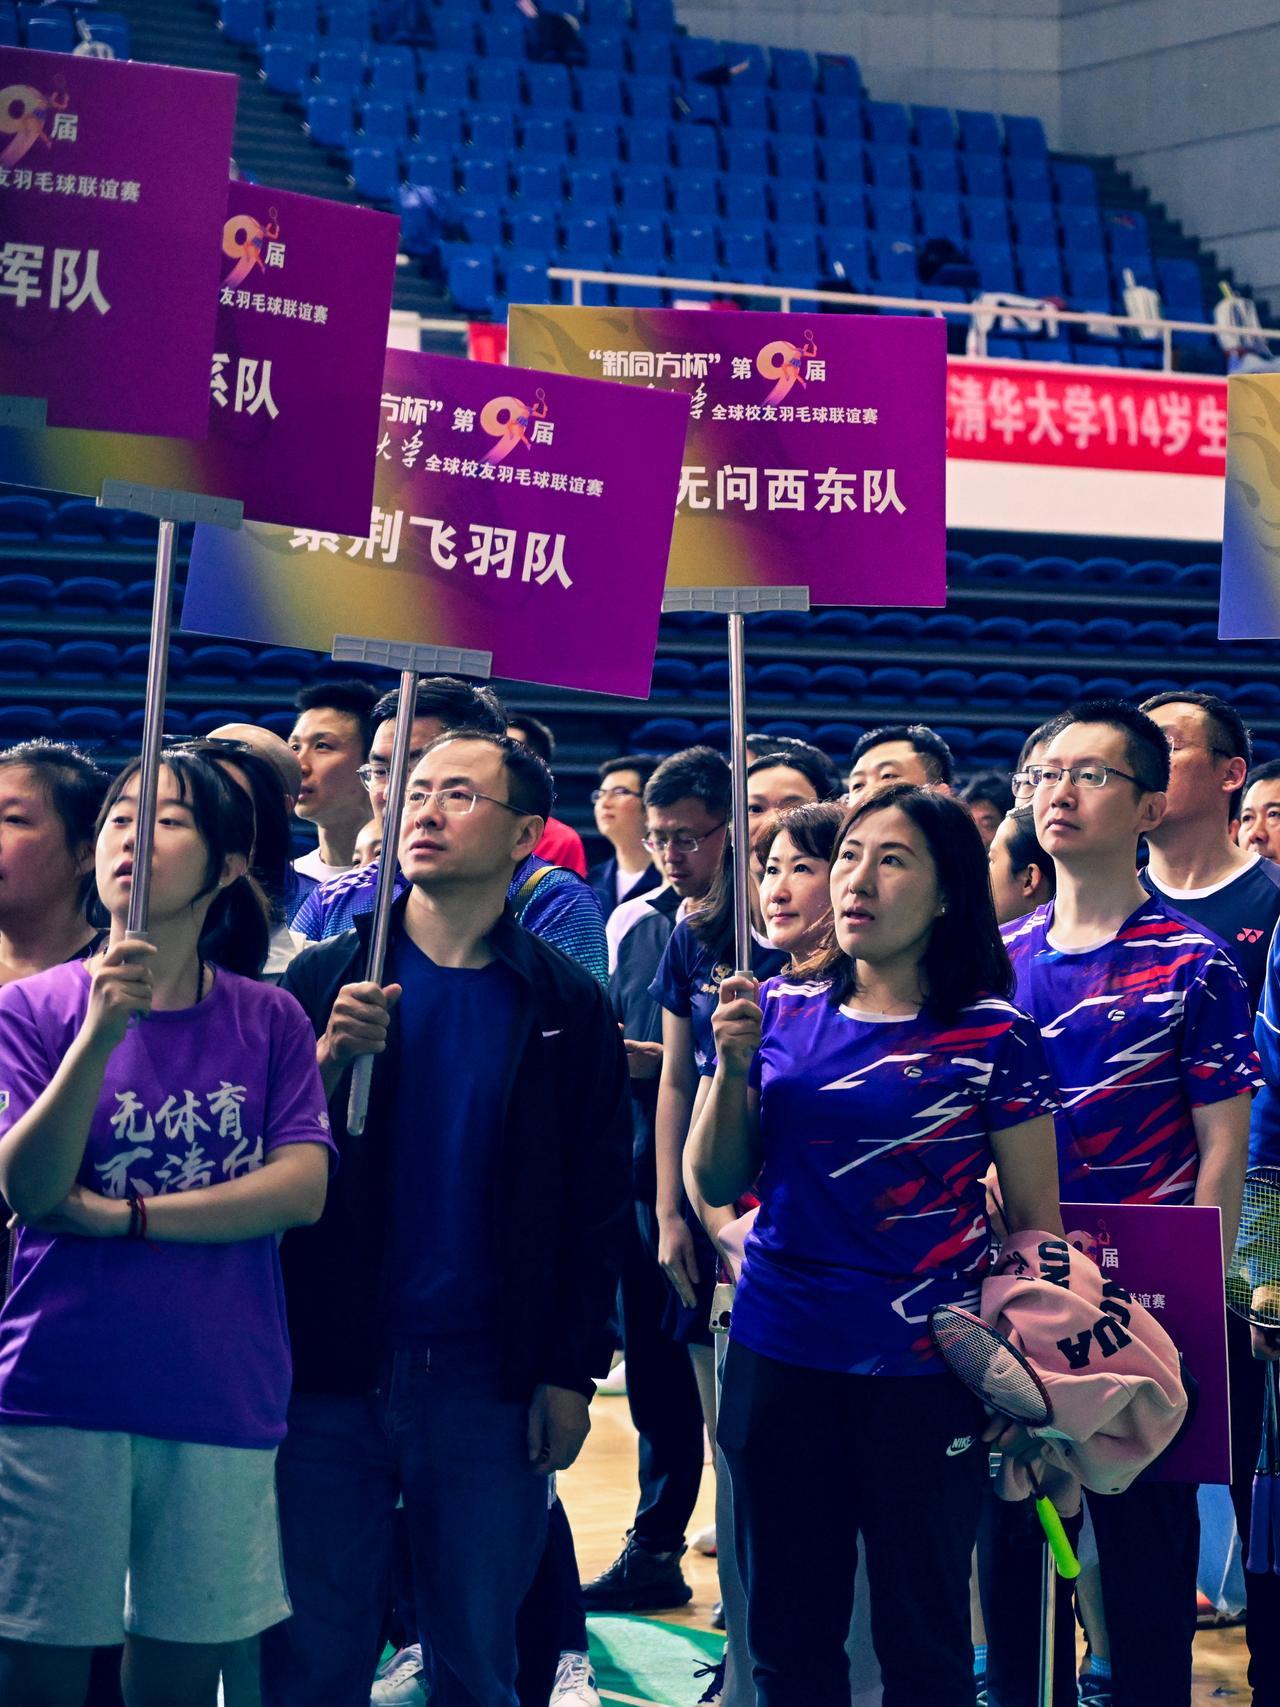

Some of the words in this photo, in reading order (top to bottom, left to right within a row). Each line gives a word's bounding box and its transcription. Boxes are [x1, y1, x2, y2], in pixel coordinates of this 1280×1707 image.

[220, 286, 328, 324] 友羽毛球联谊赛
[711, 404, 878, 425] 全球校友羽毛球联谊赛
[425, 453, 604, 498] 全球校友羽毛球联谊赛
[675, 465, 907, 516] 无问西东队
[110, 1080, 247, 1143] 无体育
[951, 1435, 972, 1449] NIKE
